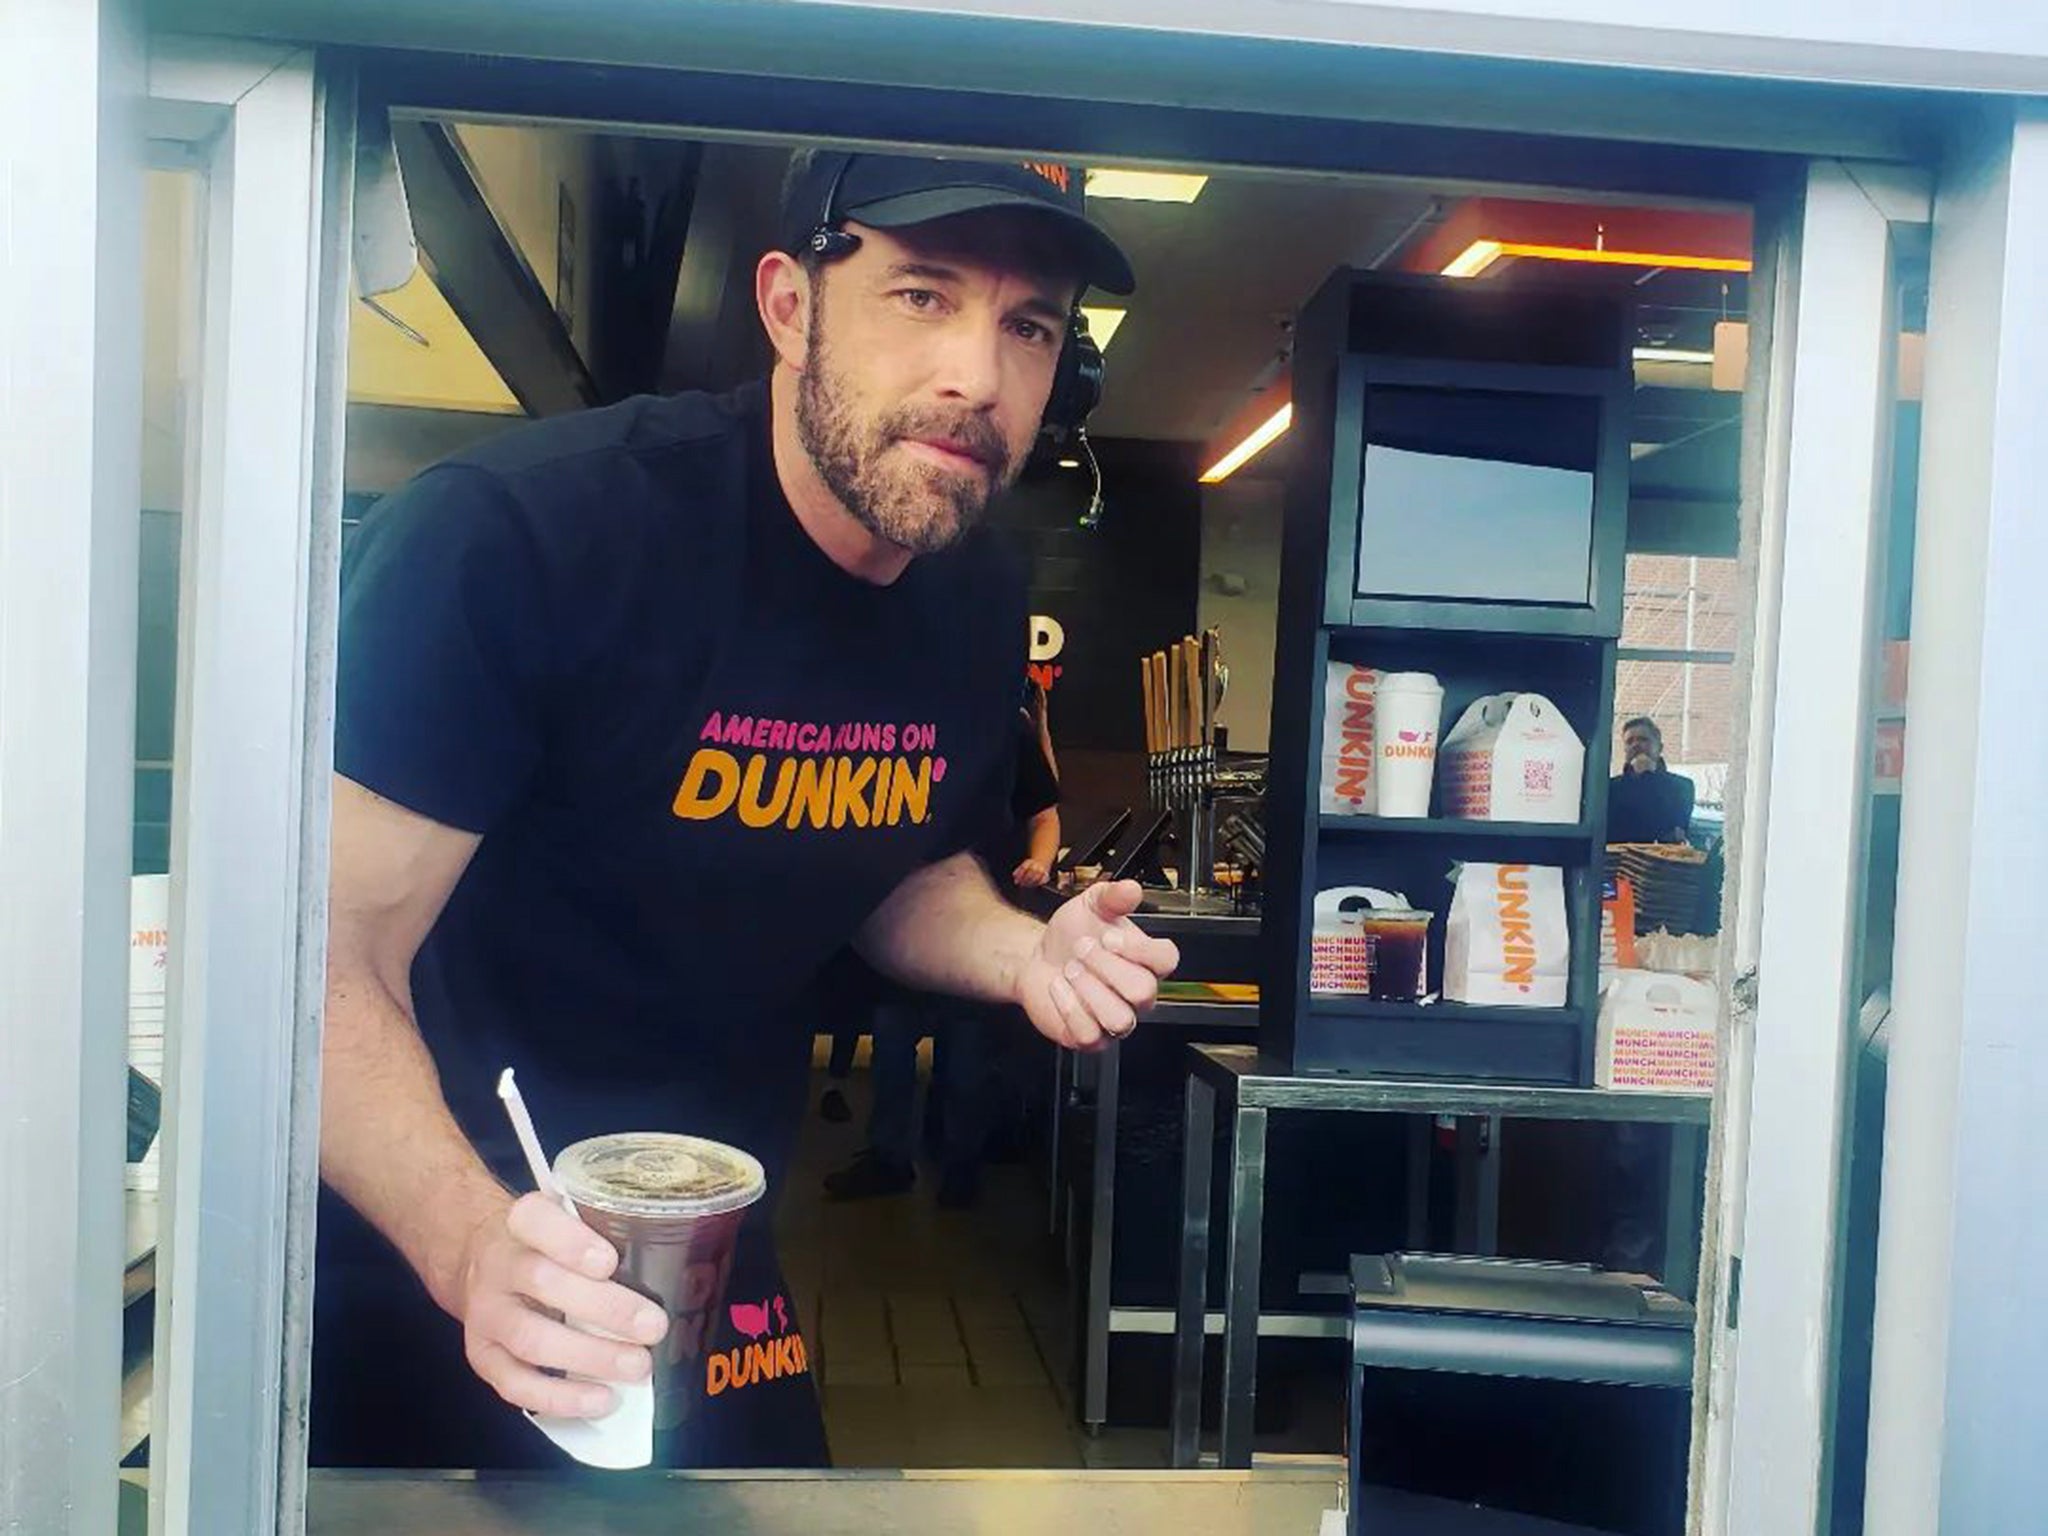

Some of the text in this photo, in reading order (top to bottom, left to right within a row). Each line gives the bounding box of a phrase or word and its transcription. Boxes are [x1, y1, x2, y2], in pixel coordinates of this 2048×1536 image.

[1029, 615, 1064, 660] D
[700, 711, 831, 752] AMERICA
[902, 723, 936, 751] ON
[1335, 661, 1376, 805] UNKIN'
[672, 748, 947, 830] DUNKIN'
